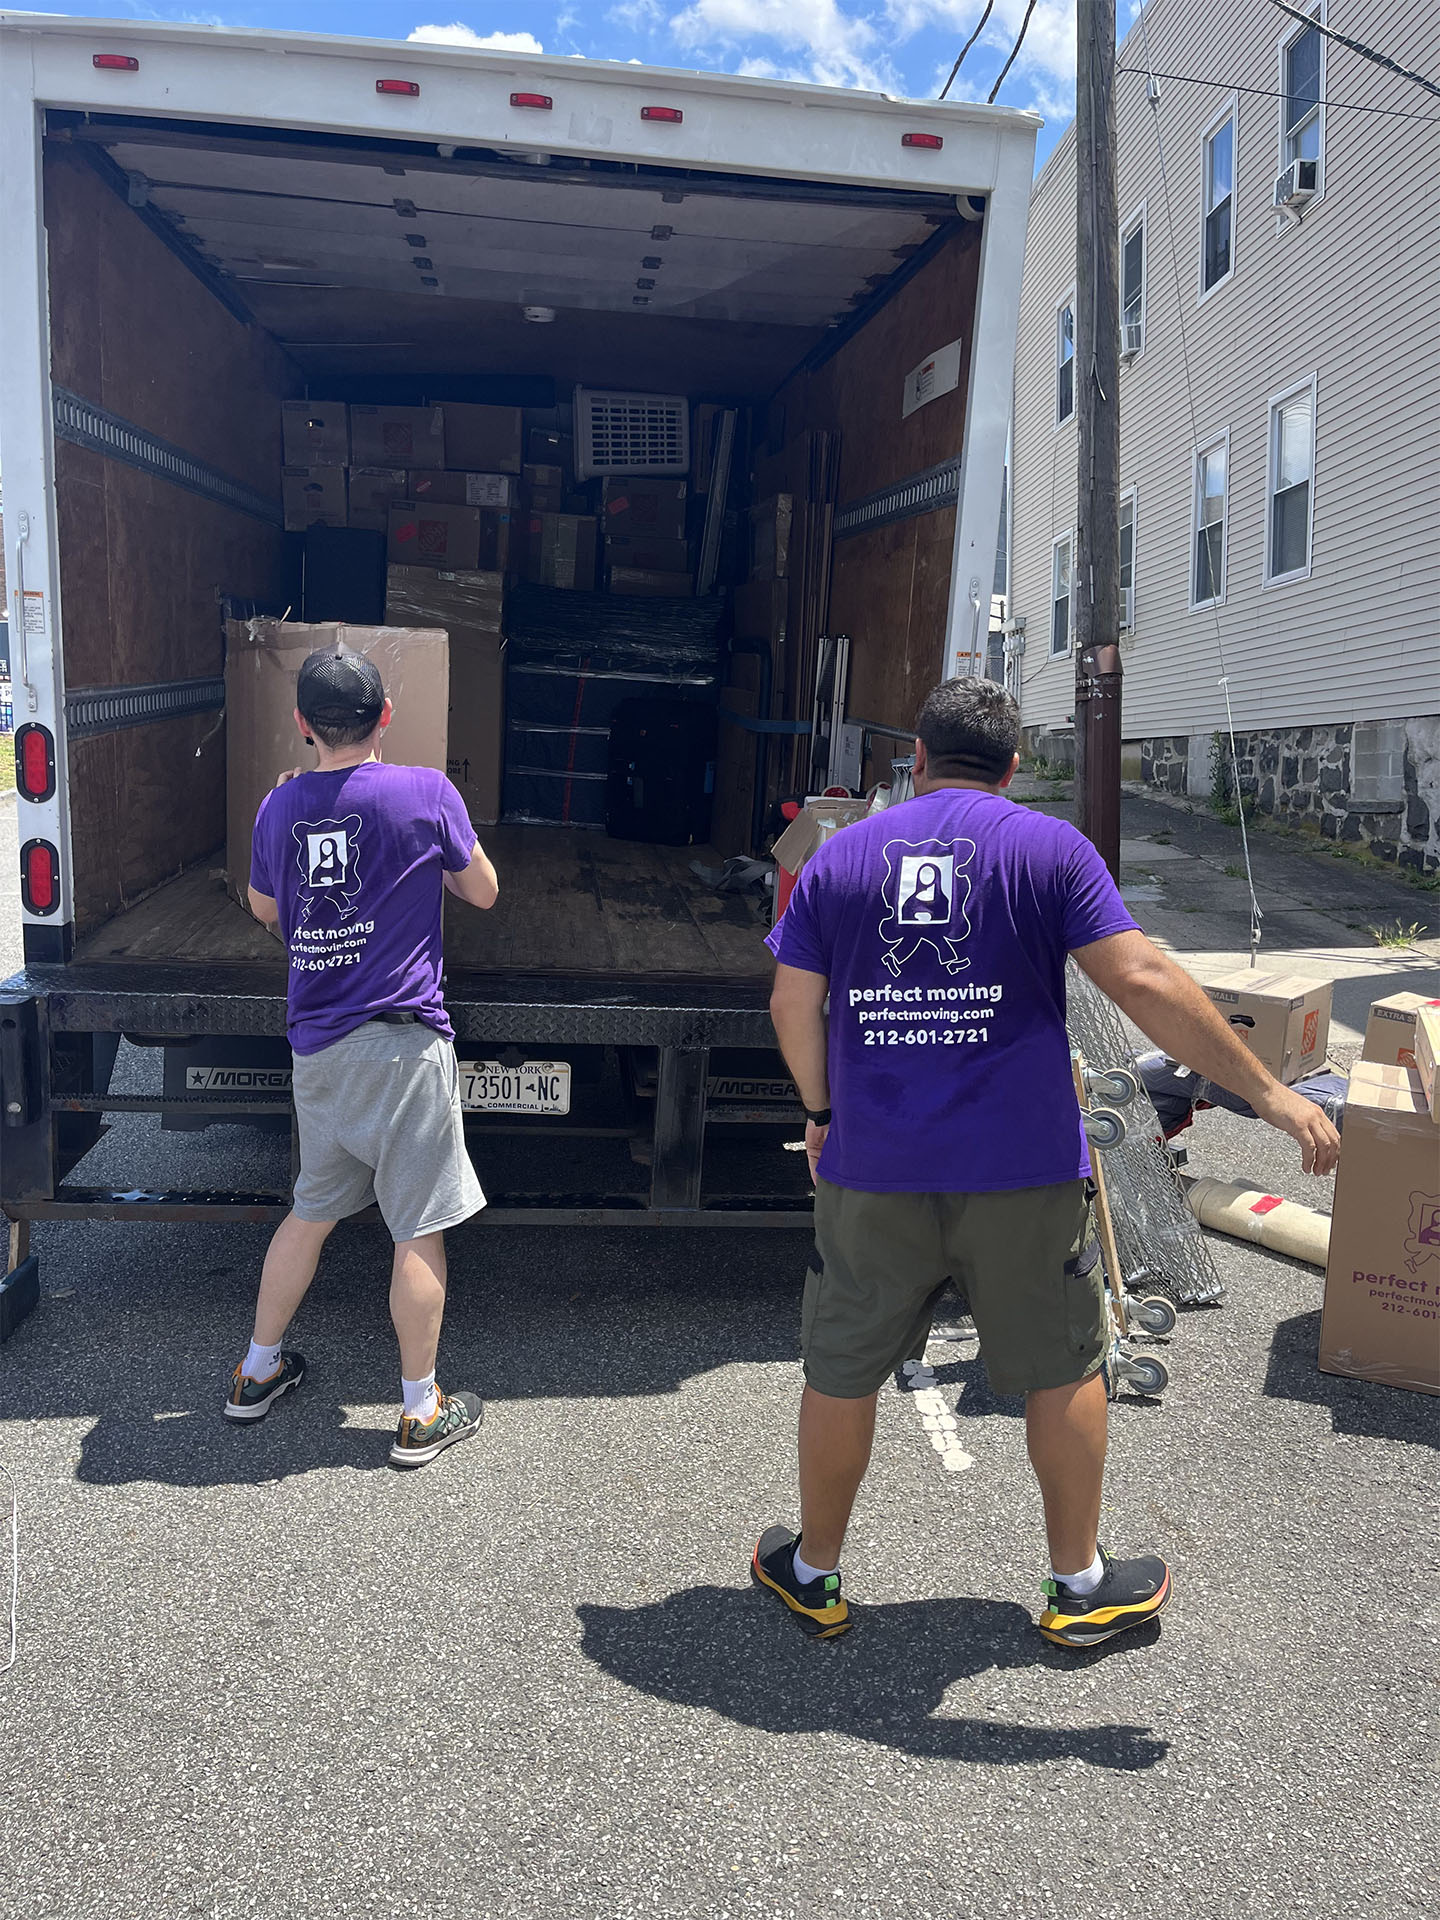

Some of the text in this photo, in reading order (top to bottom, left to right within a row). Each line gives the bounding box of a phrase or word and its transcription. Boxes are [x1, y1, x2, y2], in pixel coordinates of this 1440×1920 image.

[293, 920, 375, 940] rfect movng
[849, 982, 1003, 1006] perfect moving
[1213, 991, 1236, 1002] MALL
[858, 1007, 995, 1024] perfectmoving.com
[1376, 1009, 1405, 1021] EXTRA
[863, 1028, 988, 1045] 212-601-2721
[485, 1065, 543, 1075] NEW YORK
[212, 1071, 293, 1087] MORGA
[465, 1075, 560, 1101] 73501 NC
[717, 1080, 800, 1096] MORGA
[487, 1102, 539, 1110] COMMERCIAL
[1352, 1270, 1429, 1293] perfect
[1369, 1288, 1440, 1308] perfectmov
[1381, 1302, 1440, 1320] 212-601-
